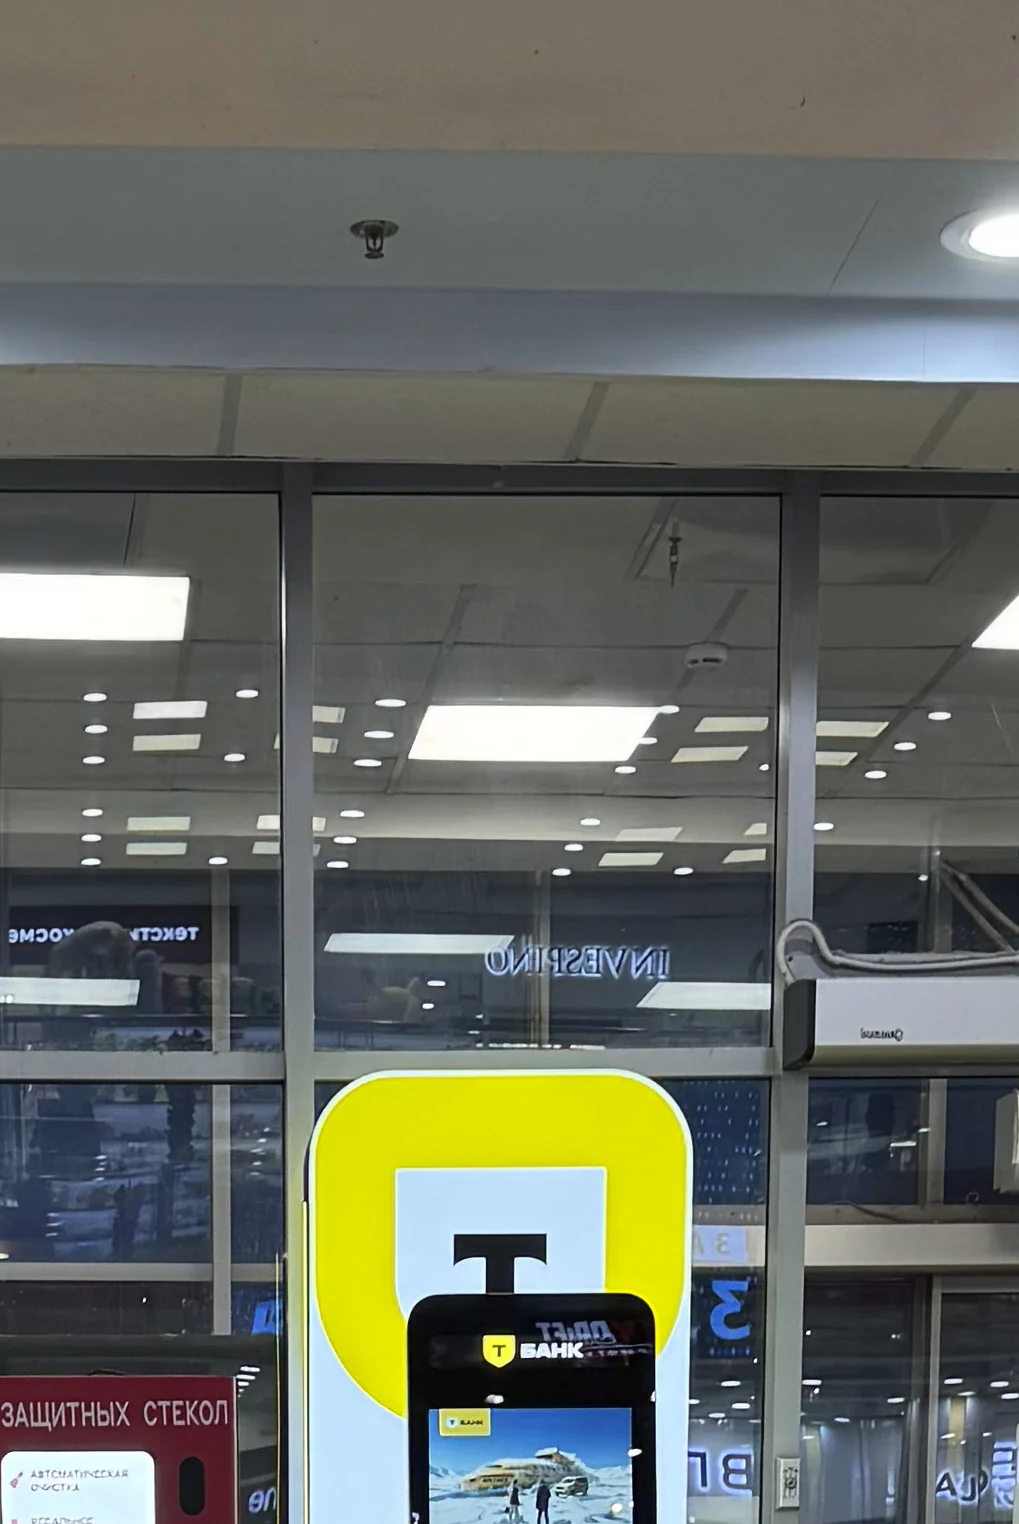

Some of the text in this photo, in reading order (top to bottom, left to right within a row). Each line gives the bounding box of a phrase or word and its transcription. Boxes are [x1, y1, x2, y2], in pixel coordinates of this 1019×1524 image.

[520, 1342, 585, 1359] БАНК
[0, 1400, 130, 1432] ЗАЩИТНЫХ
[143, 1399, 228, 1427] СТЕКОЛ
